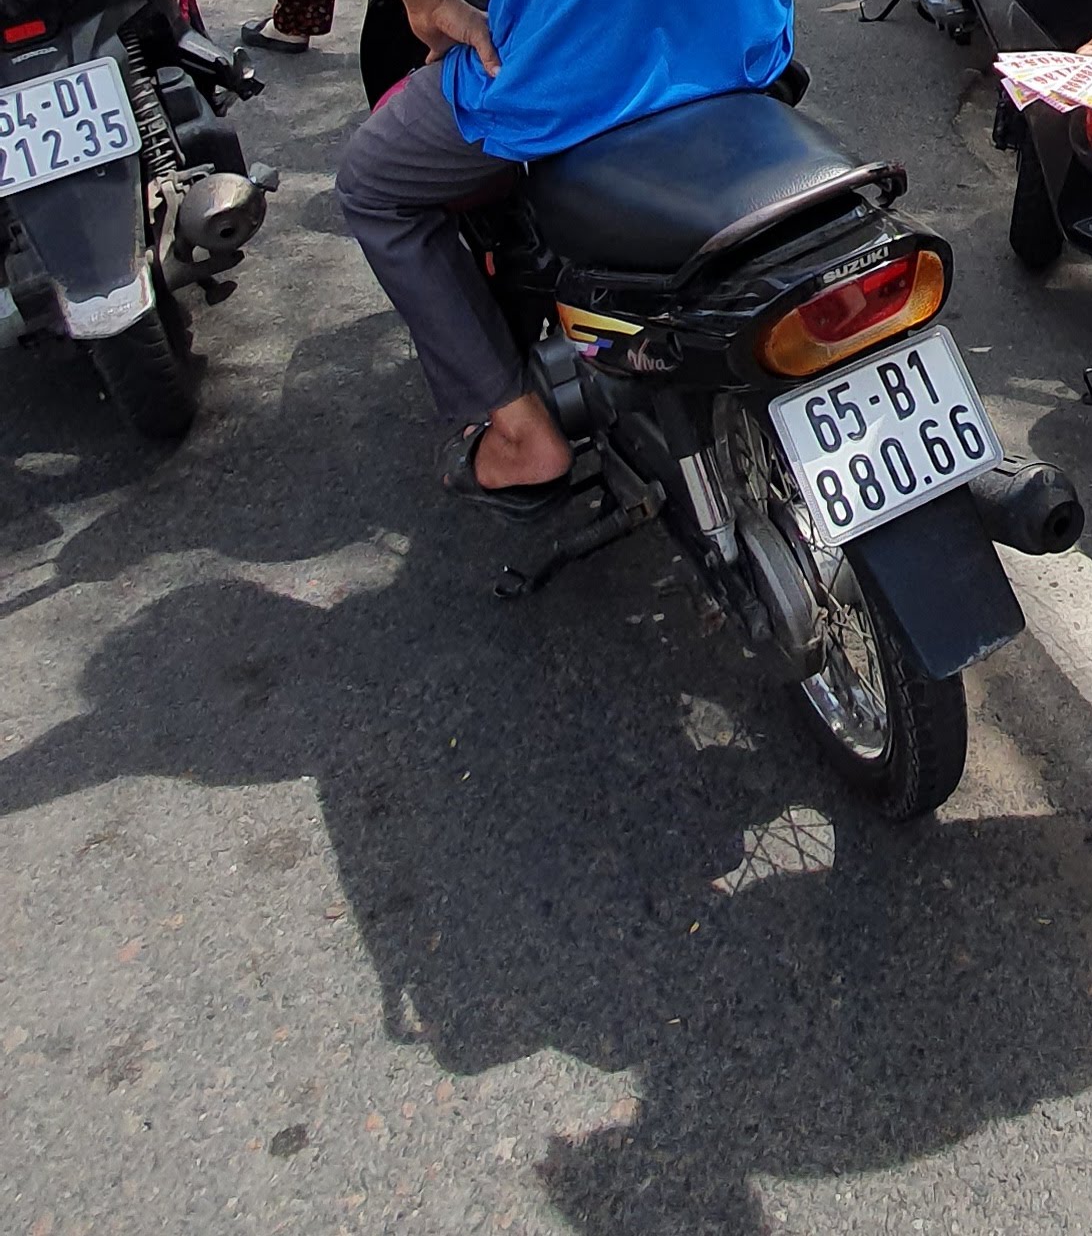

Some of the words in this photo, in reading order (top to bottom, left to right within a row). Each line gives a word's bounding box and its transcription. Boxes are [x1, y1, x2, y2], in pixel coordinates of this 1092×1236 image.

[822, 246, 890, 285] SUZUKI
[627, 338, 676, 371] Viva
[805, 350, 940, 454] 65-B1
[816, 404, 986, 527] 880.66
